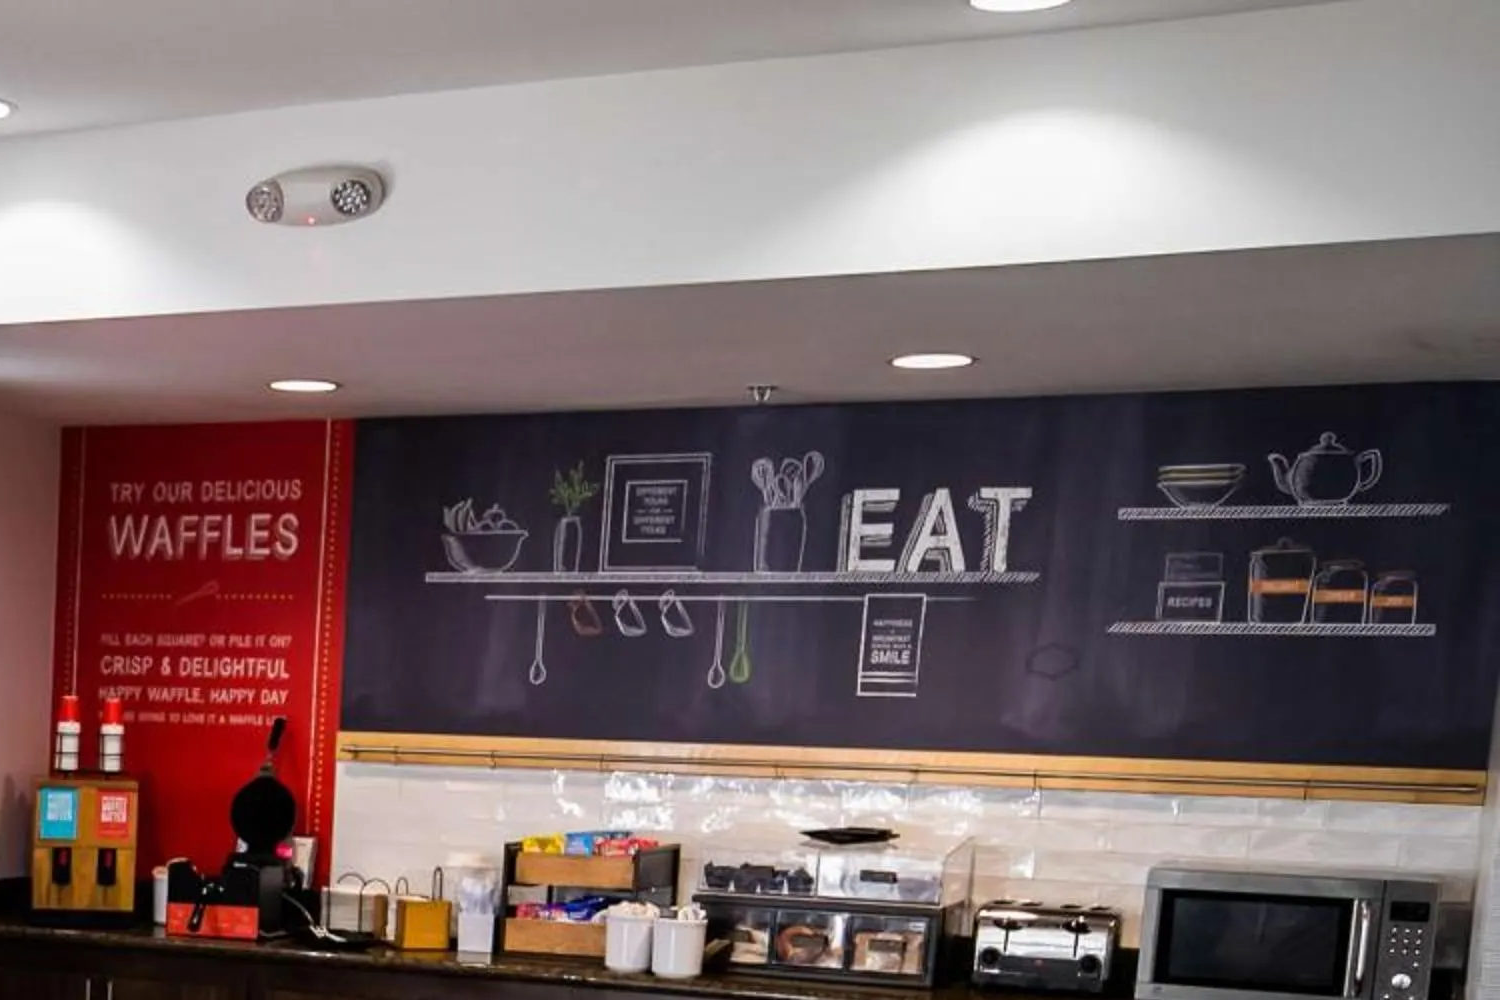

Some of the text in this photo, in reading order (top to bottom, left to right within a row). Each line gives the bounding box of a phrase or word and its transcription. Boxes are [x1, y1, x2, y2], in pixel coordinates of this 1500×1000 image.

[110, 479, 302, 503] TRY OUR DELICIOUS
[108, 513, 299, 558] WAFFLES
[840, 486, 1033, 573] EAT
[209, 634, 226, 647] OR
[100, 655, 290, 679] CRISP & DELIGHTFUL
[870, 650, 910, 664] SMILE
[98, 685, 142, 700] HAPPY
[210, 688, 256, 704] HAPPY
[260, 690, 289, 705] DAY
